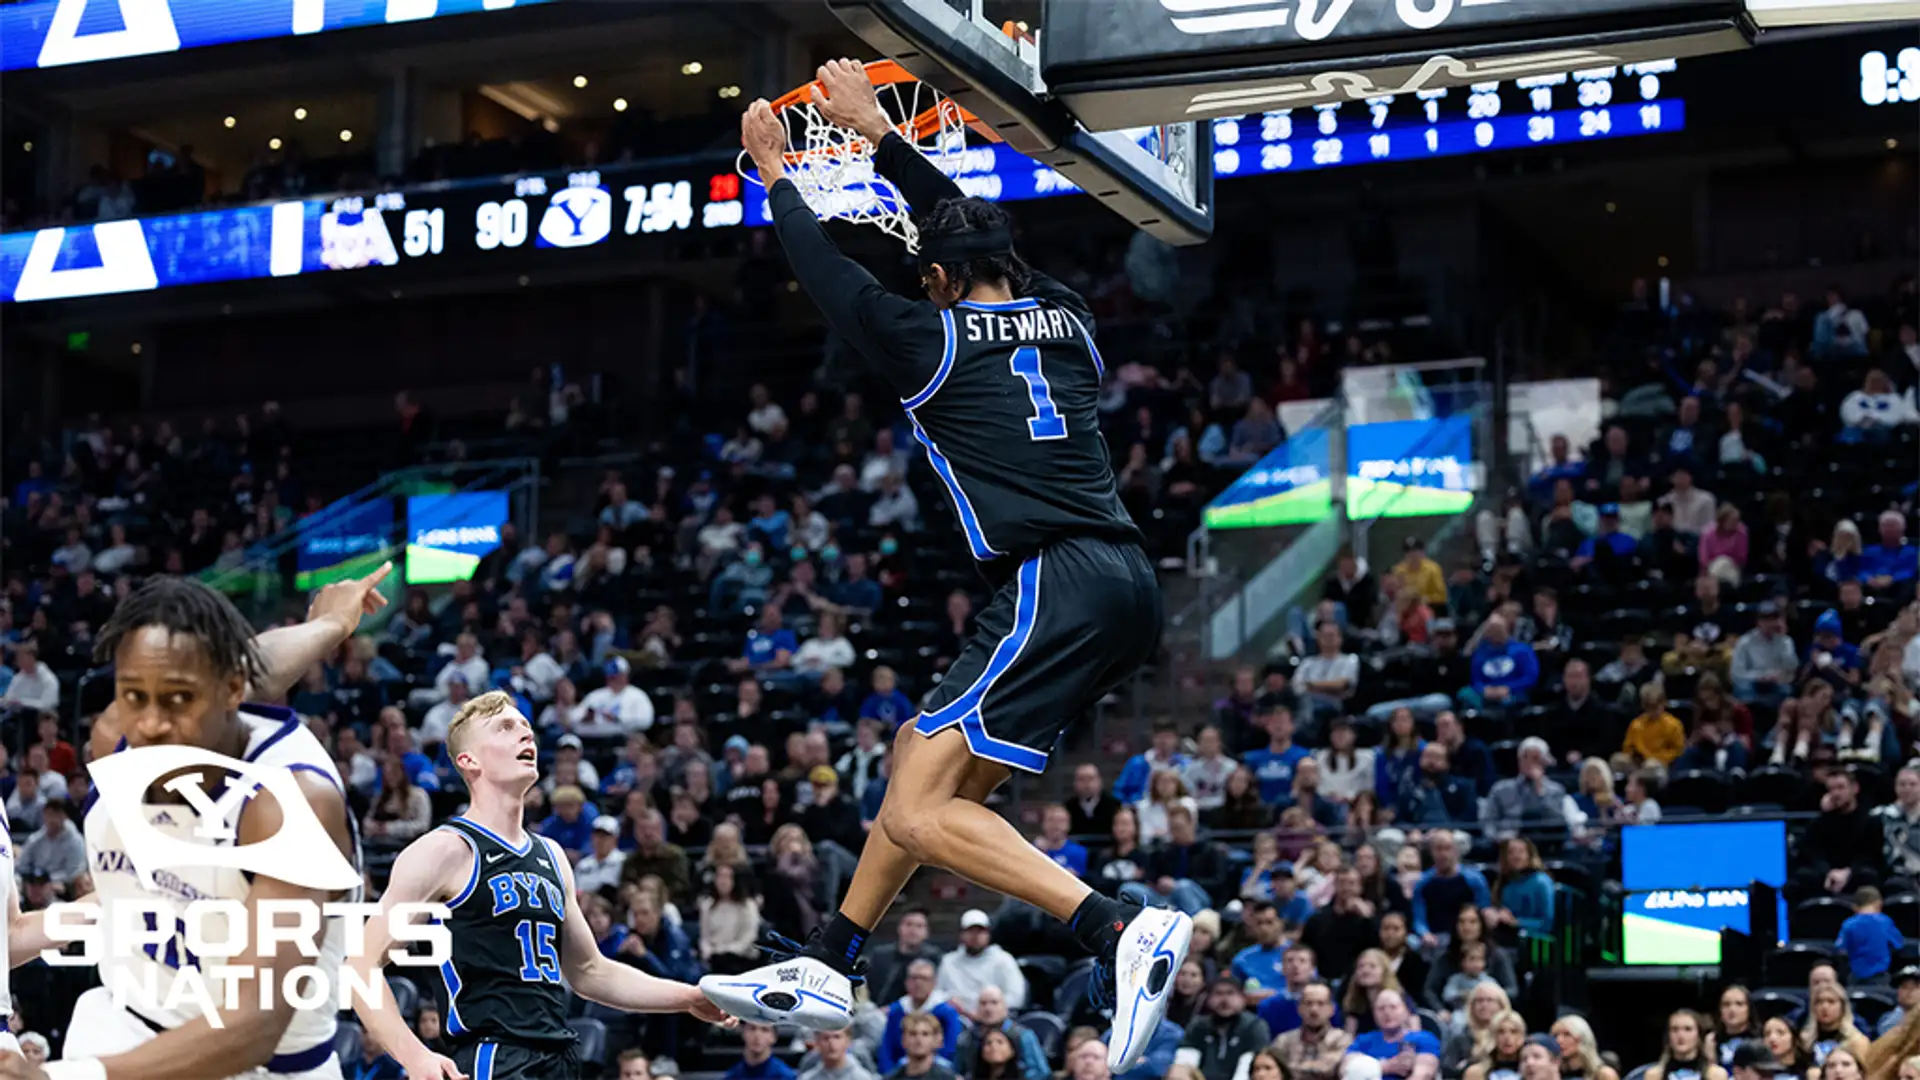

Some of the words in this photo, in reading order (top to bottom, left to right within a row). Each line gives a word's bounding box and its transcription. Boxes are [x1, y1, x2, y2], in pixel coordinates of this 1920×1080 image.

[1370, 103, 1389, 129] 7
[1424, 100, 1438, 123] 1
[1467, 92, 1501, 119] 20
[1529, 87, 1552, 111] 11
[1578, 80, 1612, 106] 30
[1313, 138, 1343, 165] 22
[1369, 133, 1390, 158] 11
[1425, 128, 1438, 152] 1
[1528, 116, 1555, 142] 31
[1579, 109, 1612, 136] 24
[1639, 104, 1661, 129] 11
[403, 208, 445, 257] 51
[476, 198, 528, 250] 90
[624, 181, 692, 234] 7:54
[966, 309, 1073, 342] STEWART
[1009, 346, 1068, 441] 1
[488, 872, 565, 921] BYU
[515, 919, 561, 984] 15
